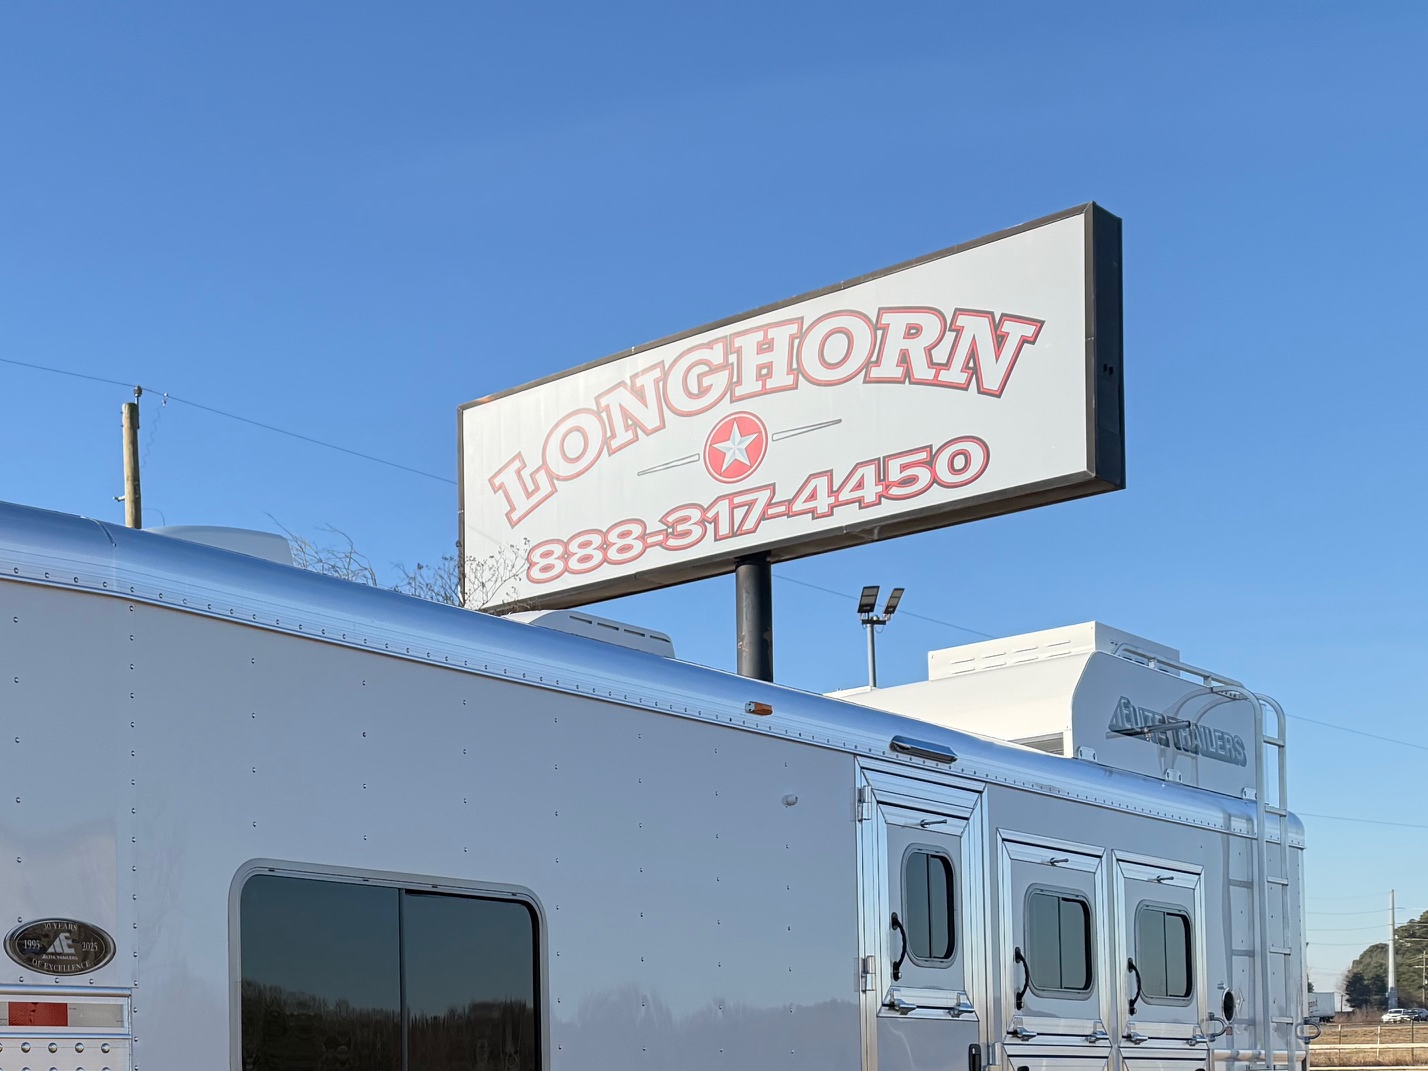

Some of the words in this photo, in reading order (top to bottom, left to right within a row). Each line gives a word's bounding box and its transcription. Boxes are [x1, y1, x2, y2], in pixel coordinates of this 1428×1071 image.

[490, 306, 1045, 528] LONGHORN
[526, 436, 991, 585] 888-317-4450
[1166, 715, 1247, 767] TRAILERS
[52, 922, 78, 931] YEARS
[24, 939, 41, 949] 1995
[81, 941, 98, 951] 2025
[32, 958, 43, 967] OF
[44, 960, 91, 972] EXCELLENCE
